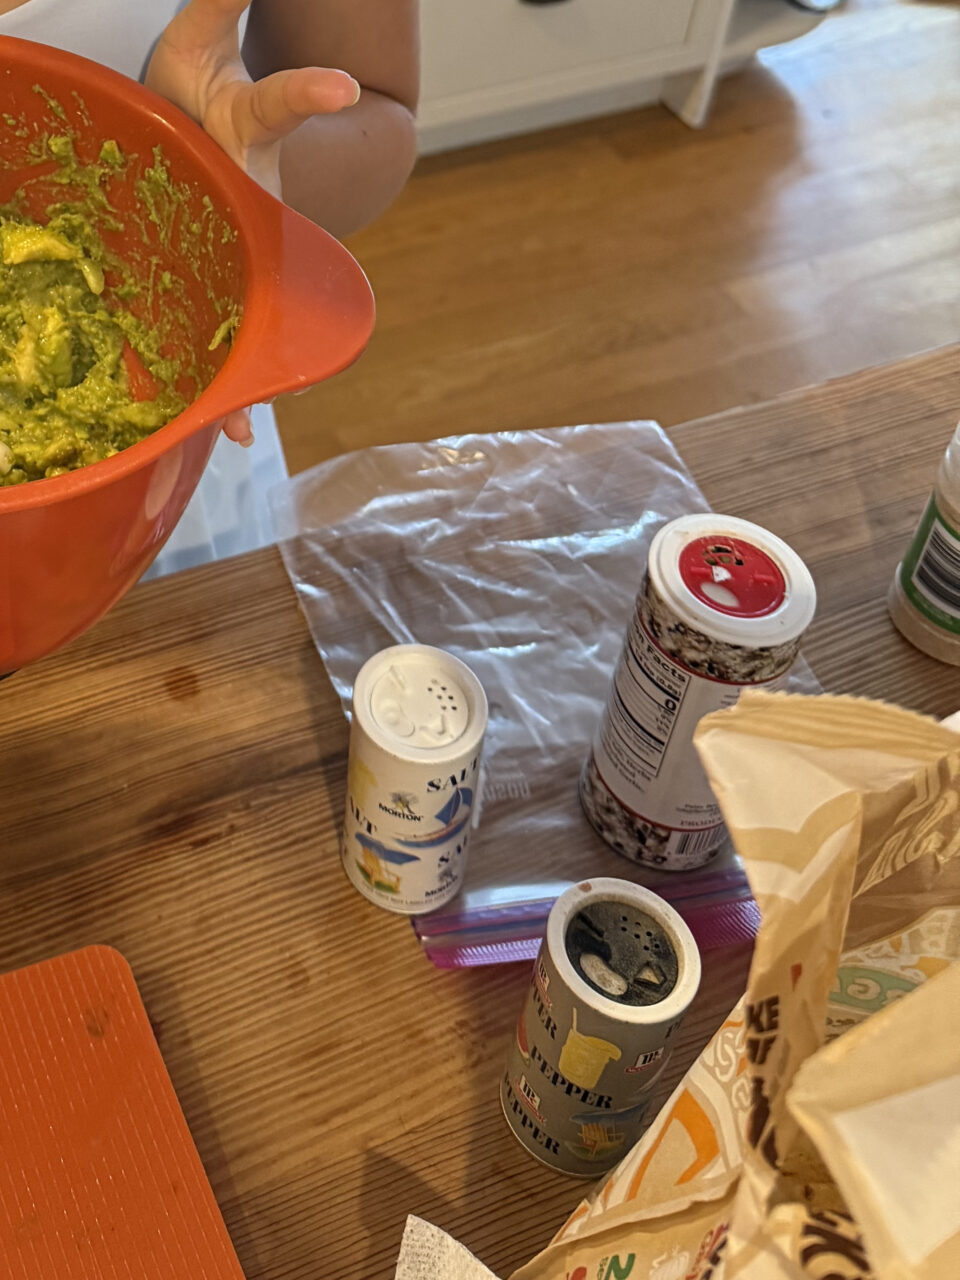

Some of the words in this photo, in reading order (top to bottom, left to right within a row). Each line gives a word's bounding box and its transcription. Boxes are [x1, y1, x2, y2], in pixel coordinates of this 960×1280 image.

[646, 645, 686, 682] Facts
[664, 698, 677, 711] 0
[378, 803, 422, 822] MORTON
[531, 1046, 613, 1109] PEPPER
[504, 1070, 560, 1155] PEPPER
